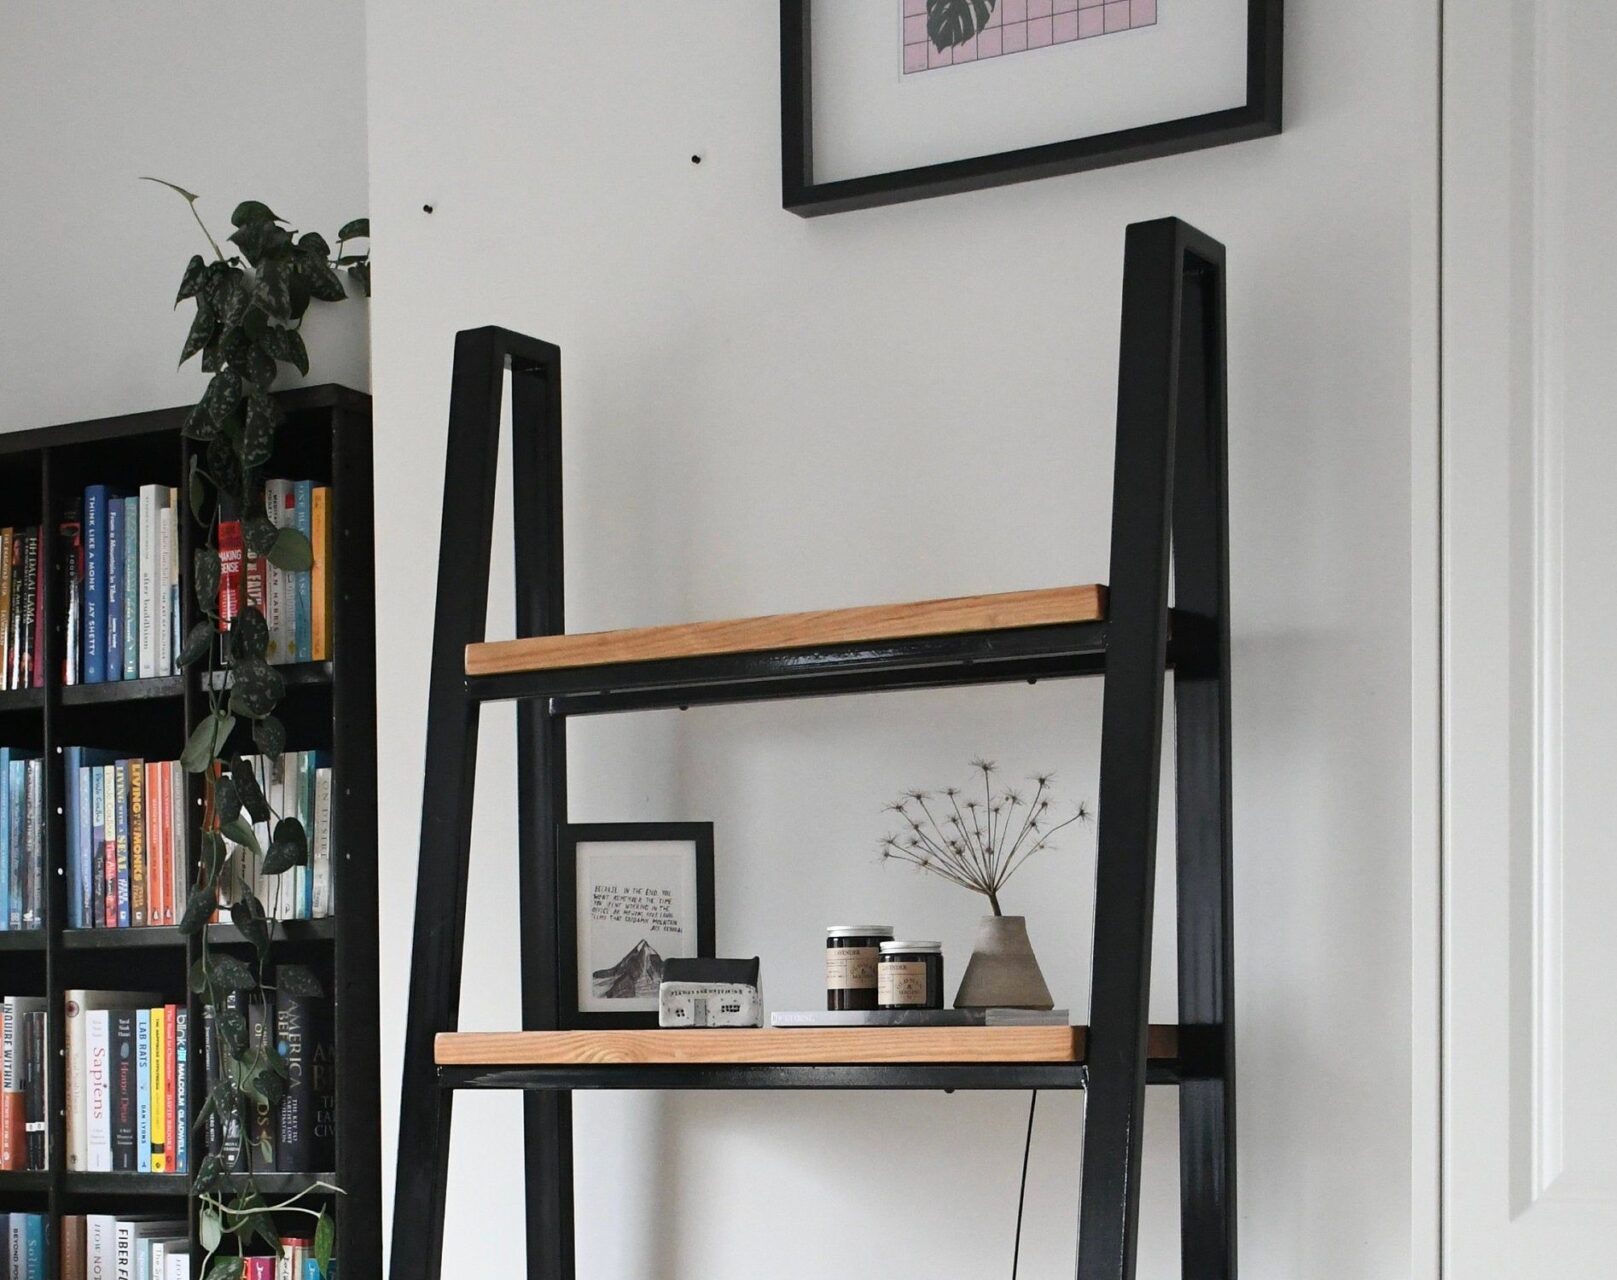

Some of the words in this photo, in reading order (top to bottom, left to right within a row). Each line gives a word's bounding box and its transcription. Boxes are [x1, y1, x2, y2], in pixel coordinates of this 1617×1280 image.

[88, 496, 96, 526] THINK
[88, 529, 96, 550] LIKE
[28, 559, 37, 590] DALAI
[88, 560, 96, 591] MONK
[143, 573, 151, 594] after
[27, 594, 36, 624] LAMA
[88, 602, 96, 617] JAY
[143, 599, 152, 650] buddhism
[88, 620, 96, 656] SHETTY
[116, 766, 124, 804] LIVING
[132, 764, 141, 814] LIVING
[322, 780, 330, 800] ON
[117, 834, 128, 873] SEAL
[133, 832, 143, 881] MONKS
[4, 1003, 13, 1046] INQUIRE
[139, 1022, 147, 1042] LAB
[177, 1014, 187, 1046] blink
[139, 1044, 148, 1068] RATS
[289, 999, 303, 1090] AMERICA
[4, 1049, 13, 1089] WITHIN
[90, 1047, 107, 1120] Sapiens
[120, 1061, 130, 1095] Homo
[120, 1098, 130, 1124] Deus
[178, 1109, 186, 1155] GLADWELL
[292, 1130, 299, 1142] TO
[118, 1228, 129, 1266] FIBER
